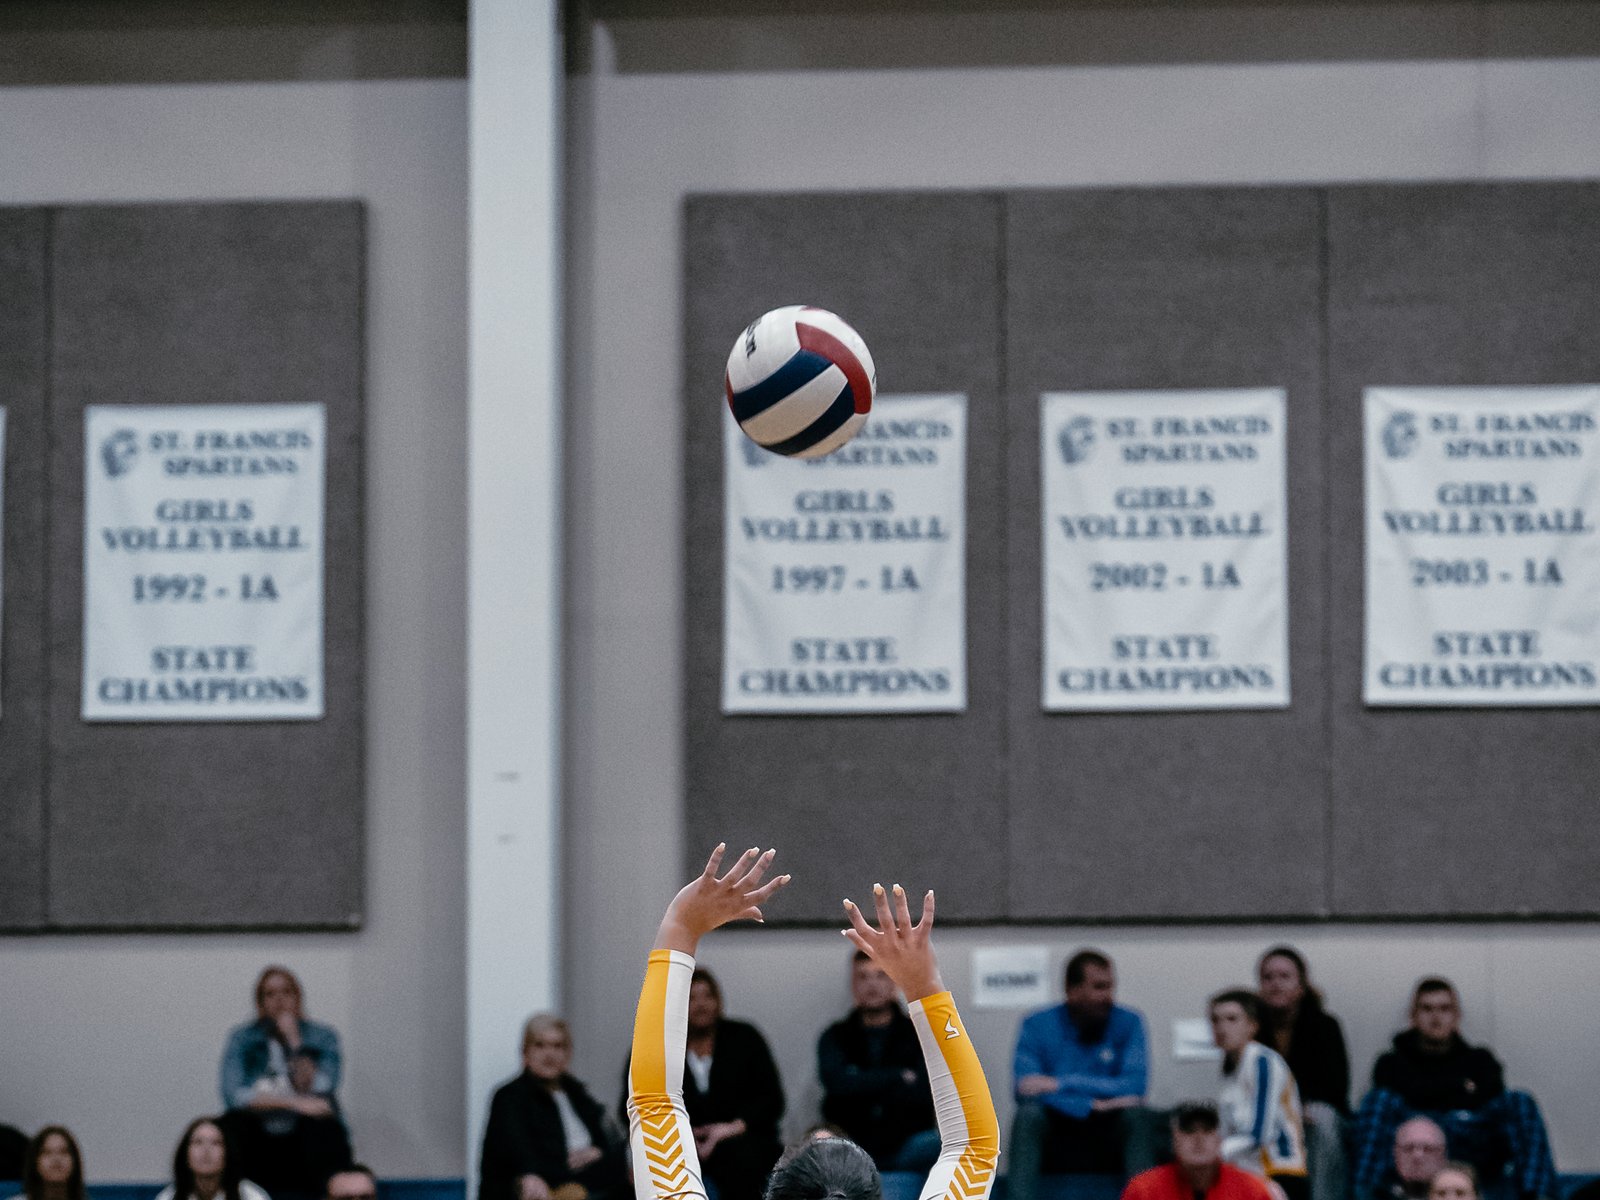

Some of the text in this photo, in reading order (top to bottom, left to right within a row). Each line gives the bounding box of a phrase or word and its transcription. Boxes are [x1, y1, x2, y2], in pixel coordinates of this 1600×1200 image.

[1150, 414, 1273, 437] FRANCIS
[1474, 409, 1598, 433] FRANCIS
[193, 427, 313, 451] FRANCIS
[1444, 437, 1584, 459] SPARTANS
[162, 455, 300, 477] SPARTANS
[1121, 442, 1259, 464] SPARTANS
[793, 490, 894, 514] GIRLS
[1113, 487, 1216, 511] GIRLS
[1435, 482, 1538, 506] GIRLS
[155, 500, 254, 523] GIRLS
[1382, 508, 1594, 536] VOLLEYBALL
[102, 526, 308, 552] VOLLEYBALL
[740, 516, 950, 543] VOLLEYBALL
[1058, 513, 1270, 540] VOLLEYBALL
[771, 565, 847, 594] 1997
[1088, 562, 1168, 592] 2002
[1409, 558, 1490, 587] 2003
[132, 574, 207, 602] 1992
[791, 638, 897, 664] STATE
[1111, 634, 1217, 661] STATE
[1432, 630, 1538, 658] STATE
[151, 646, 253, 673] STATE
[737, 669, 952, 696] CHAMPIONS
[1056, 664, 1275, 694] CHAMPIONS
[1376, 661, 1597, 690] CHAMPIONS
[97, 676, 311, 704] CHAMPIONS
